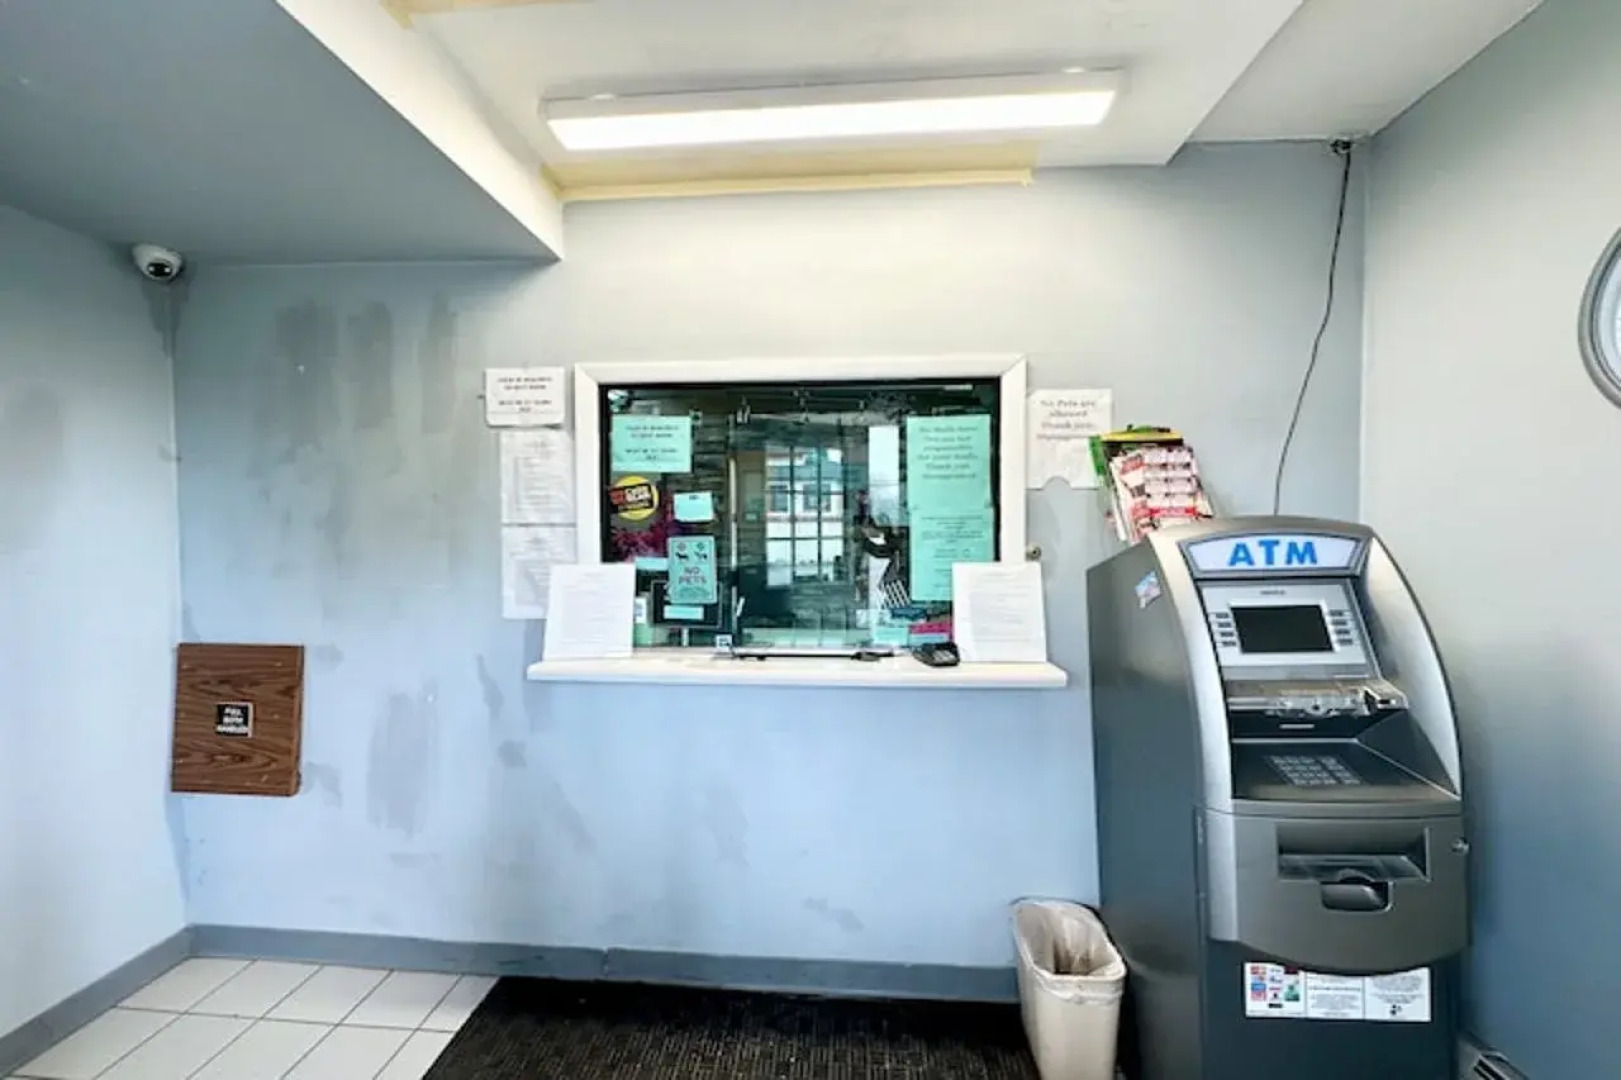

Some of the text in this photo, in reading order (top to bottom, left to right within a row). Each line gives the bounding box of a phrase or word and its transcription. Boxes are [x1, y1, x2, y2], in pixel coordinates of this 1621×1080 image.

[1227, 538, 1318, 567] ATM
[684, 566, 700, 575] NO
[678, 575, 708, 585] PETS
